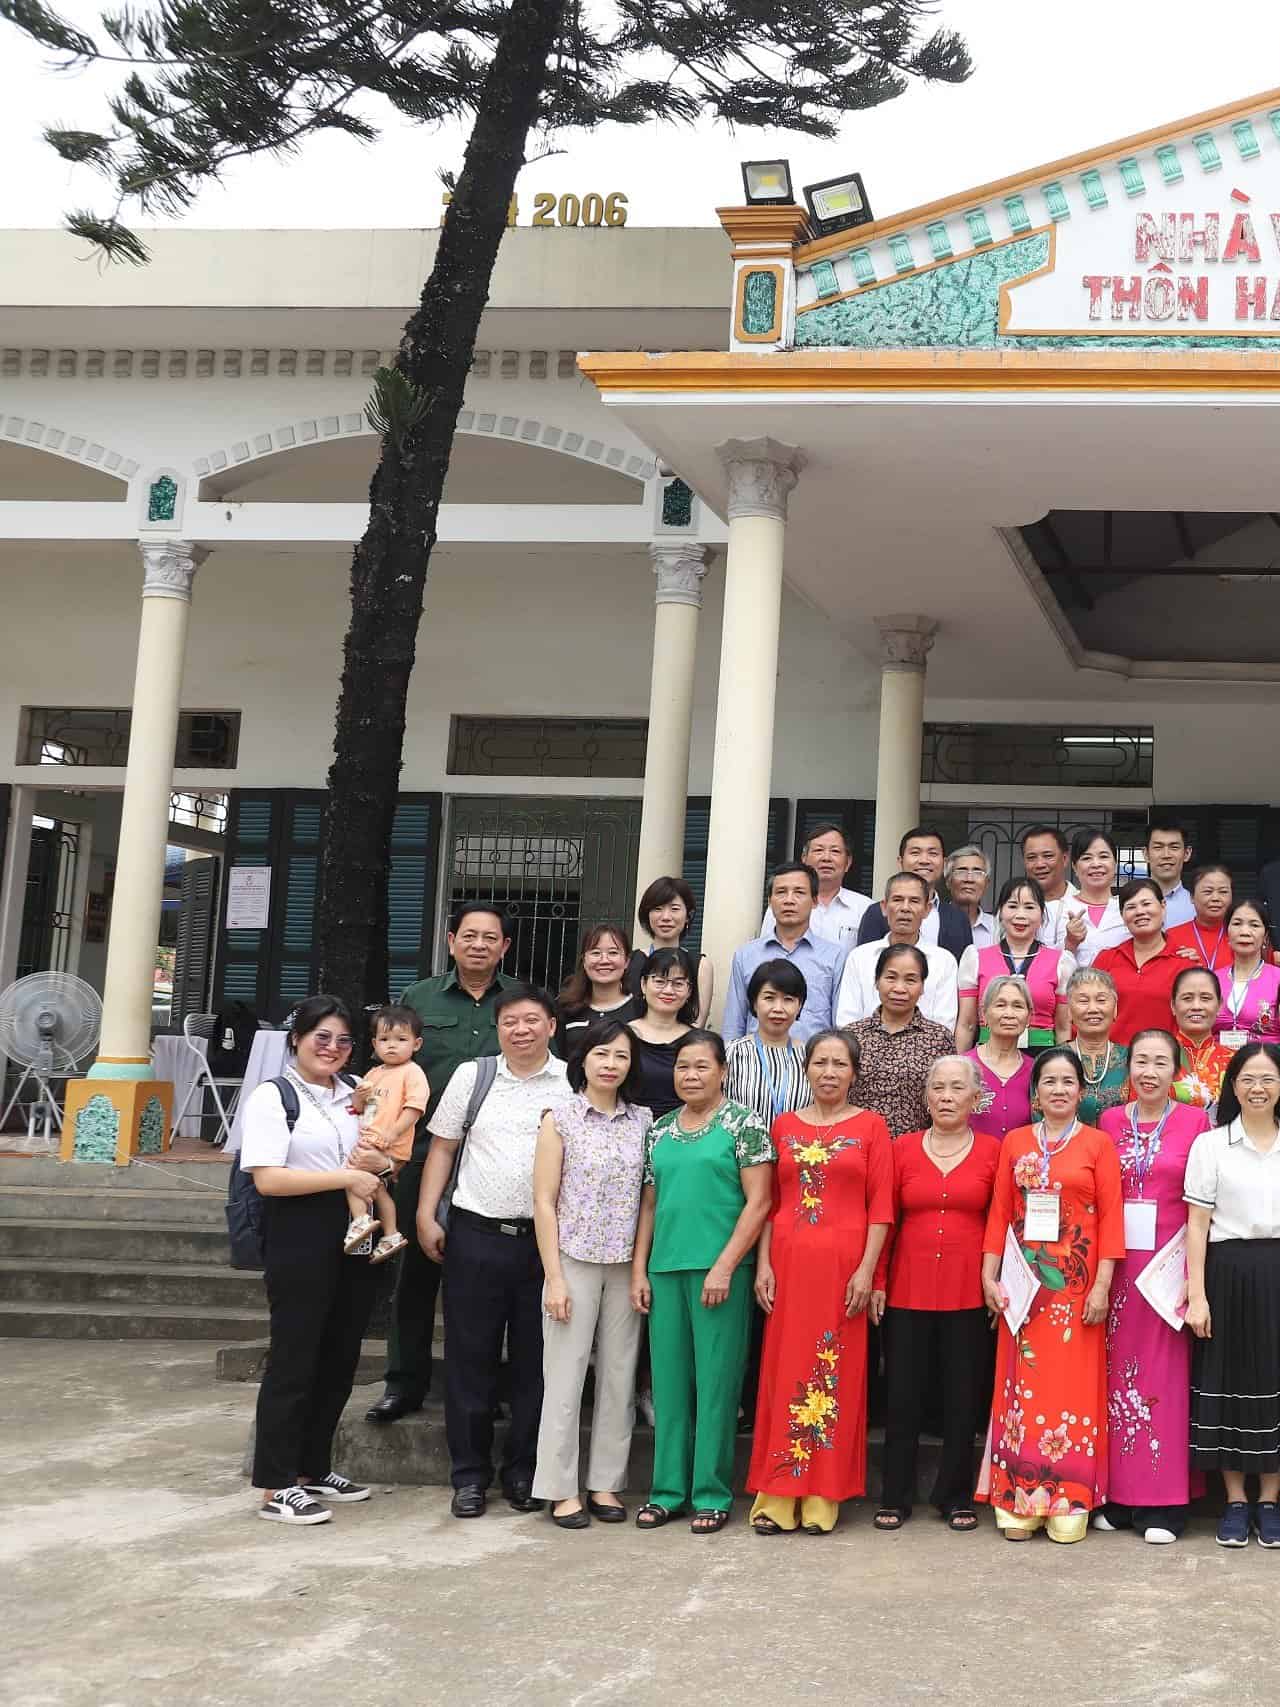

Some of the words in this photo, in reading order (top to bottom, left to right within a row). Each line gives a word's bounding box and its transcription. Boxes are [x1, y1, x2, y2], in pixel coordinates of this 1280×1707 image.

[532, 192, 628, 226] 2006
[1135, 188, 1261, 263] NHÀ
[1082, 262, 1208, 321] THÔN
